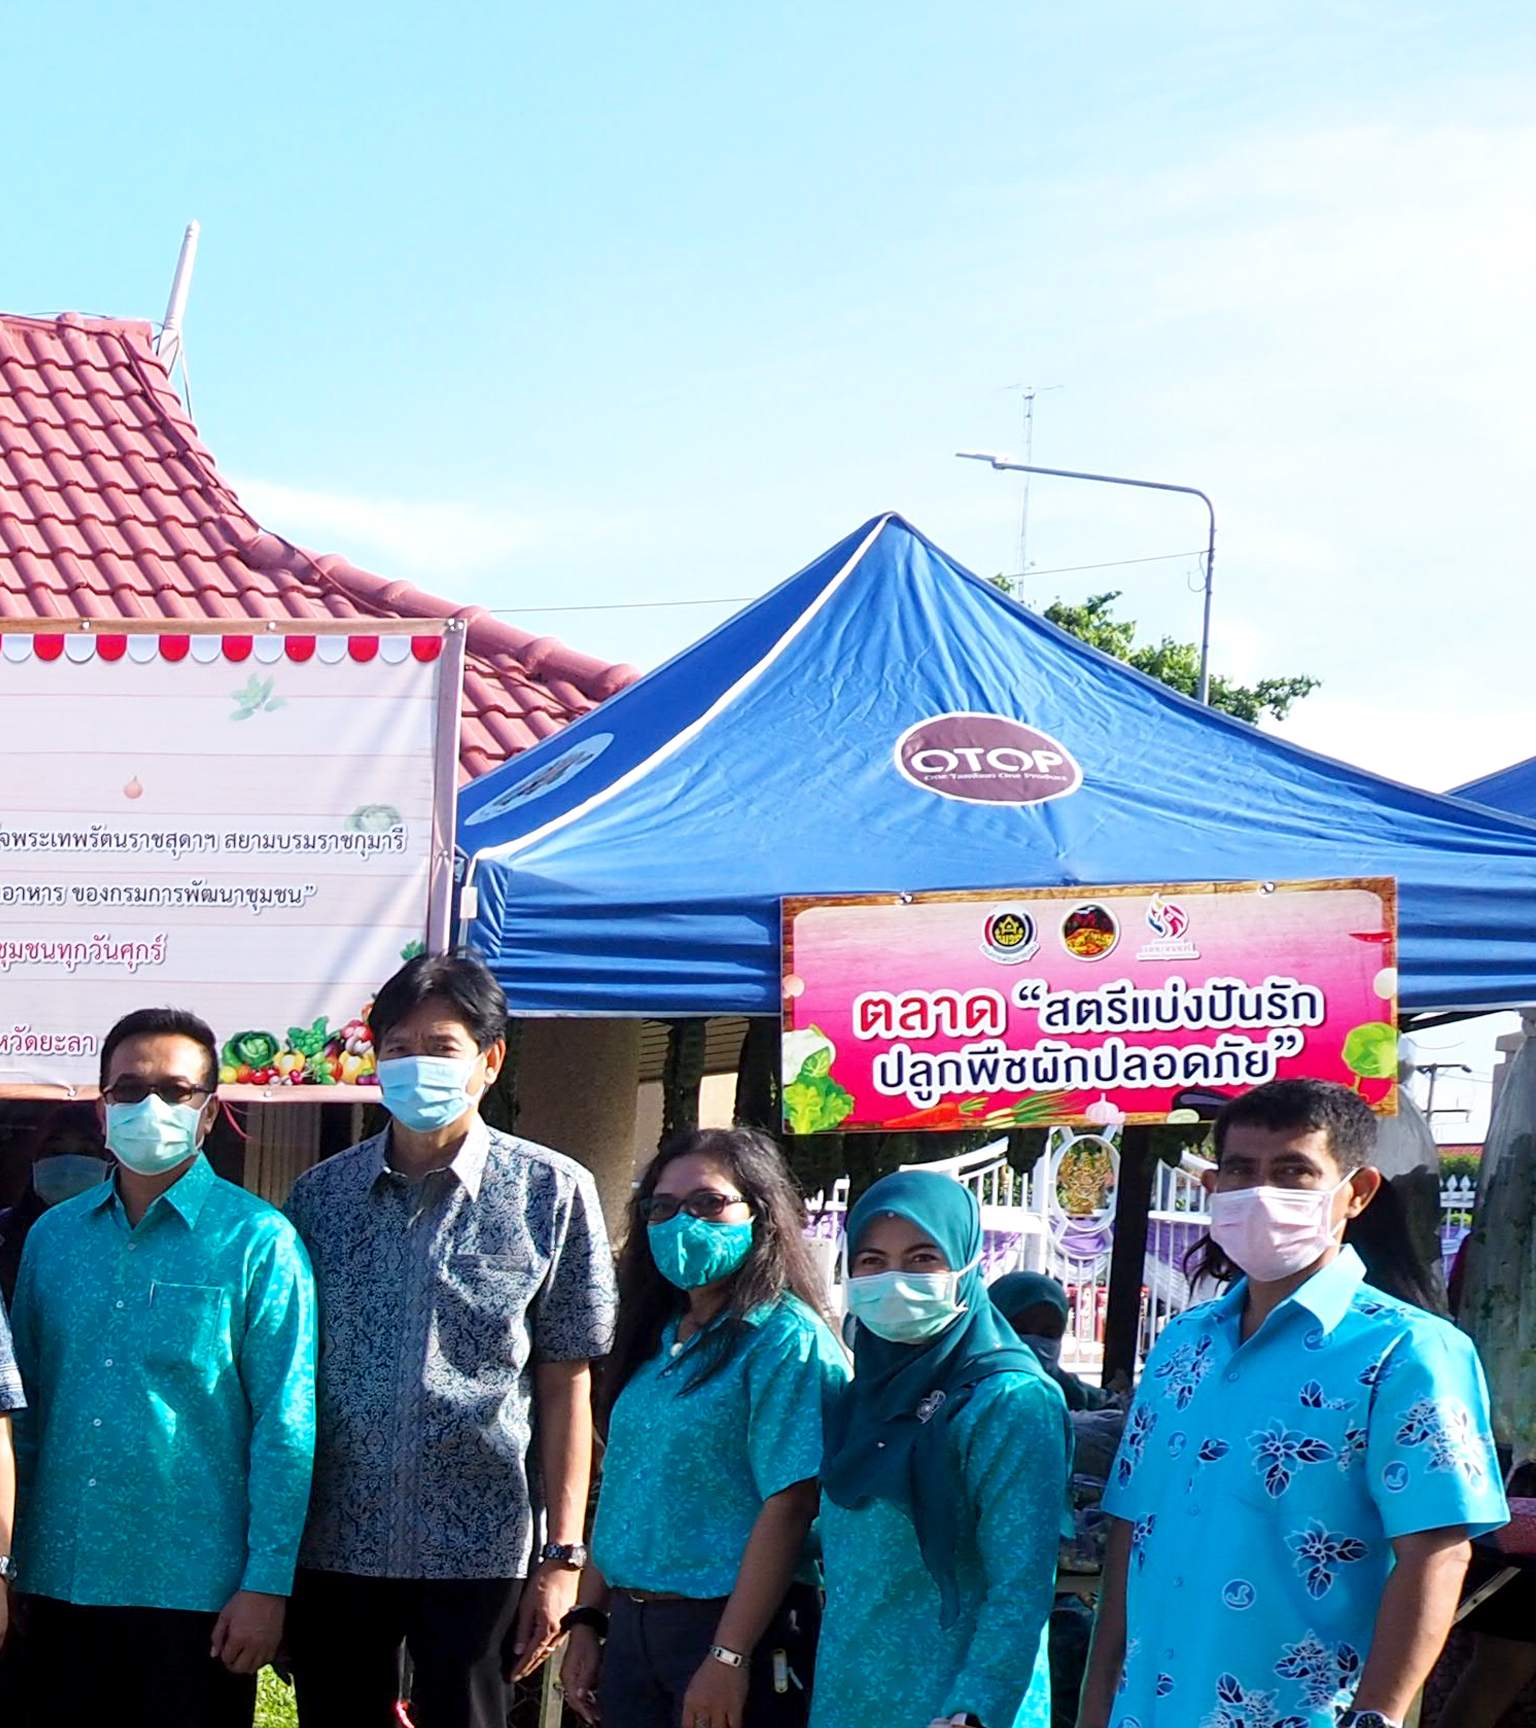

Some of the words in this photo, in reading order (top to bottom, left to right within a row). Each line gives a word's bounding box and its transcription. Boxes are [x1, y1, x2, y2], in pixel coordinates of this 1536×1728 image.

[910, 747, 1064, 773] OTOP
[224, 827, 404, 857] สยามบรมราชกุมารี
[860, 993, 1000, 1033] ตลาด
[879, 1034, 1297, 1099] ปลูกพืชผักปลอดภัย”
